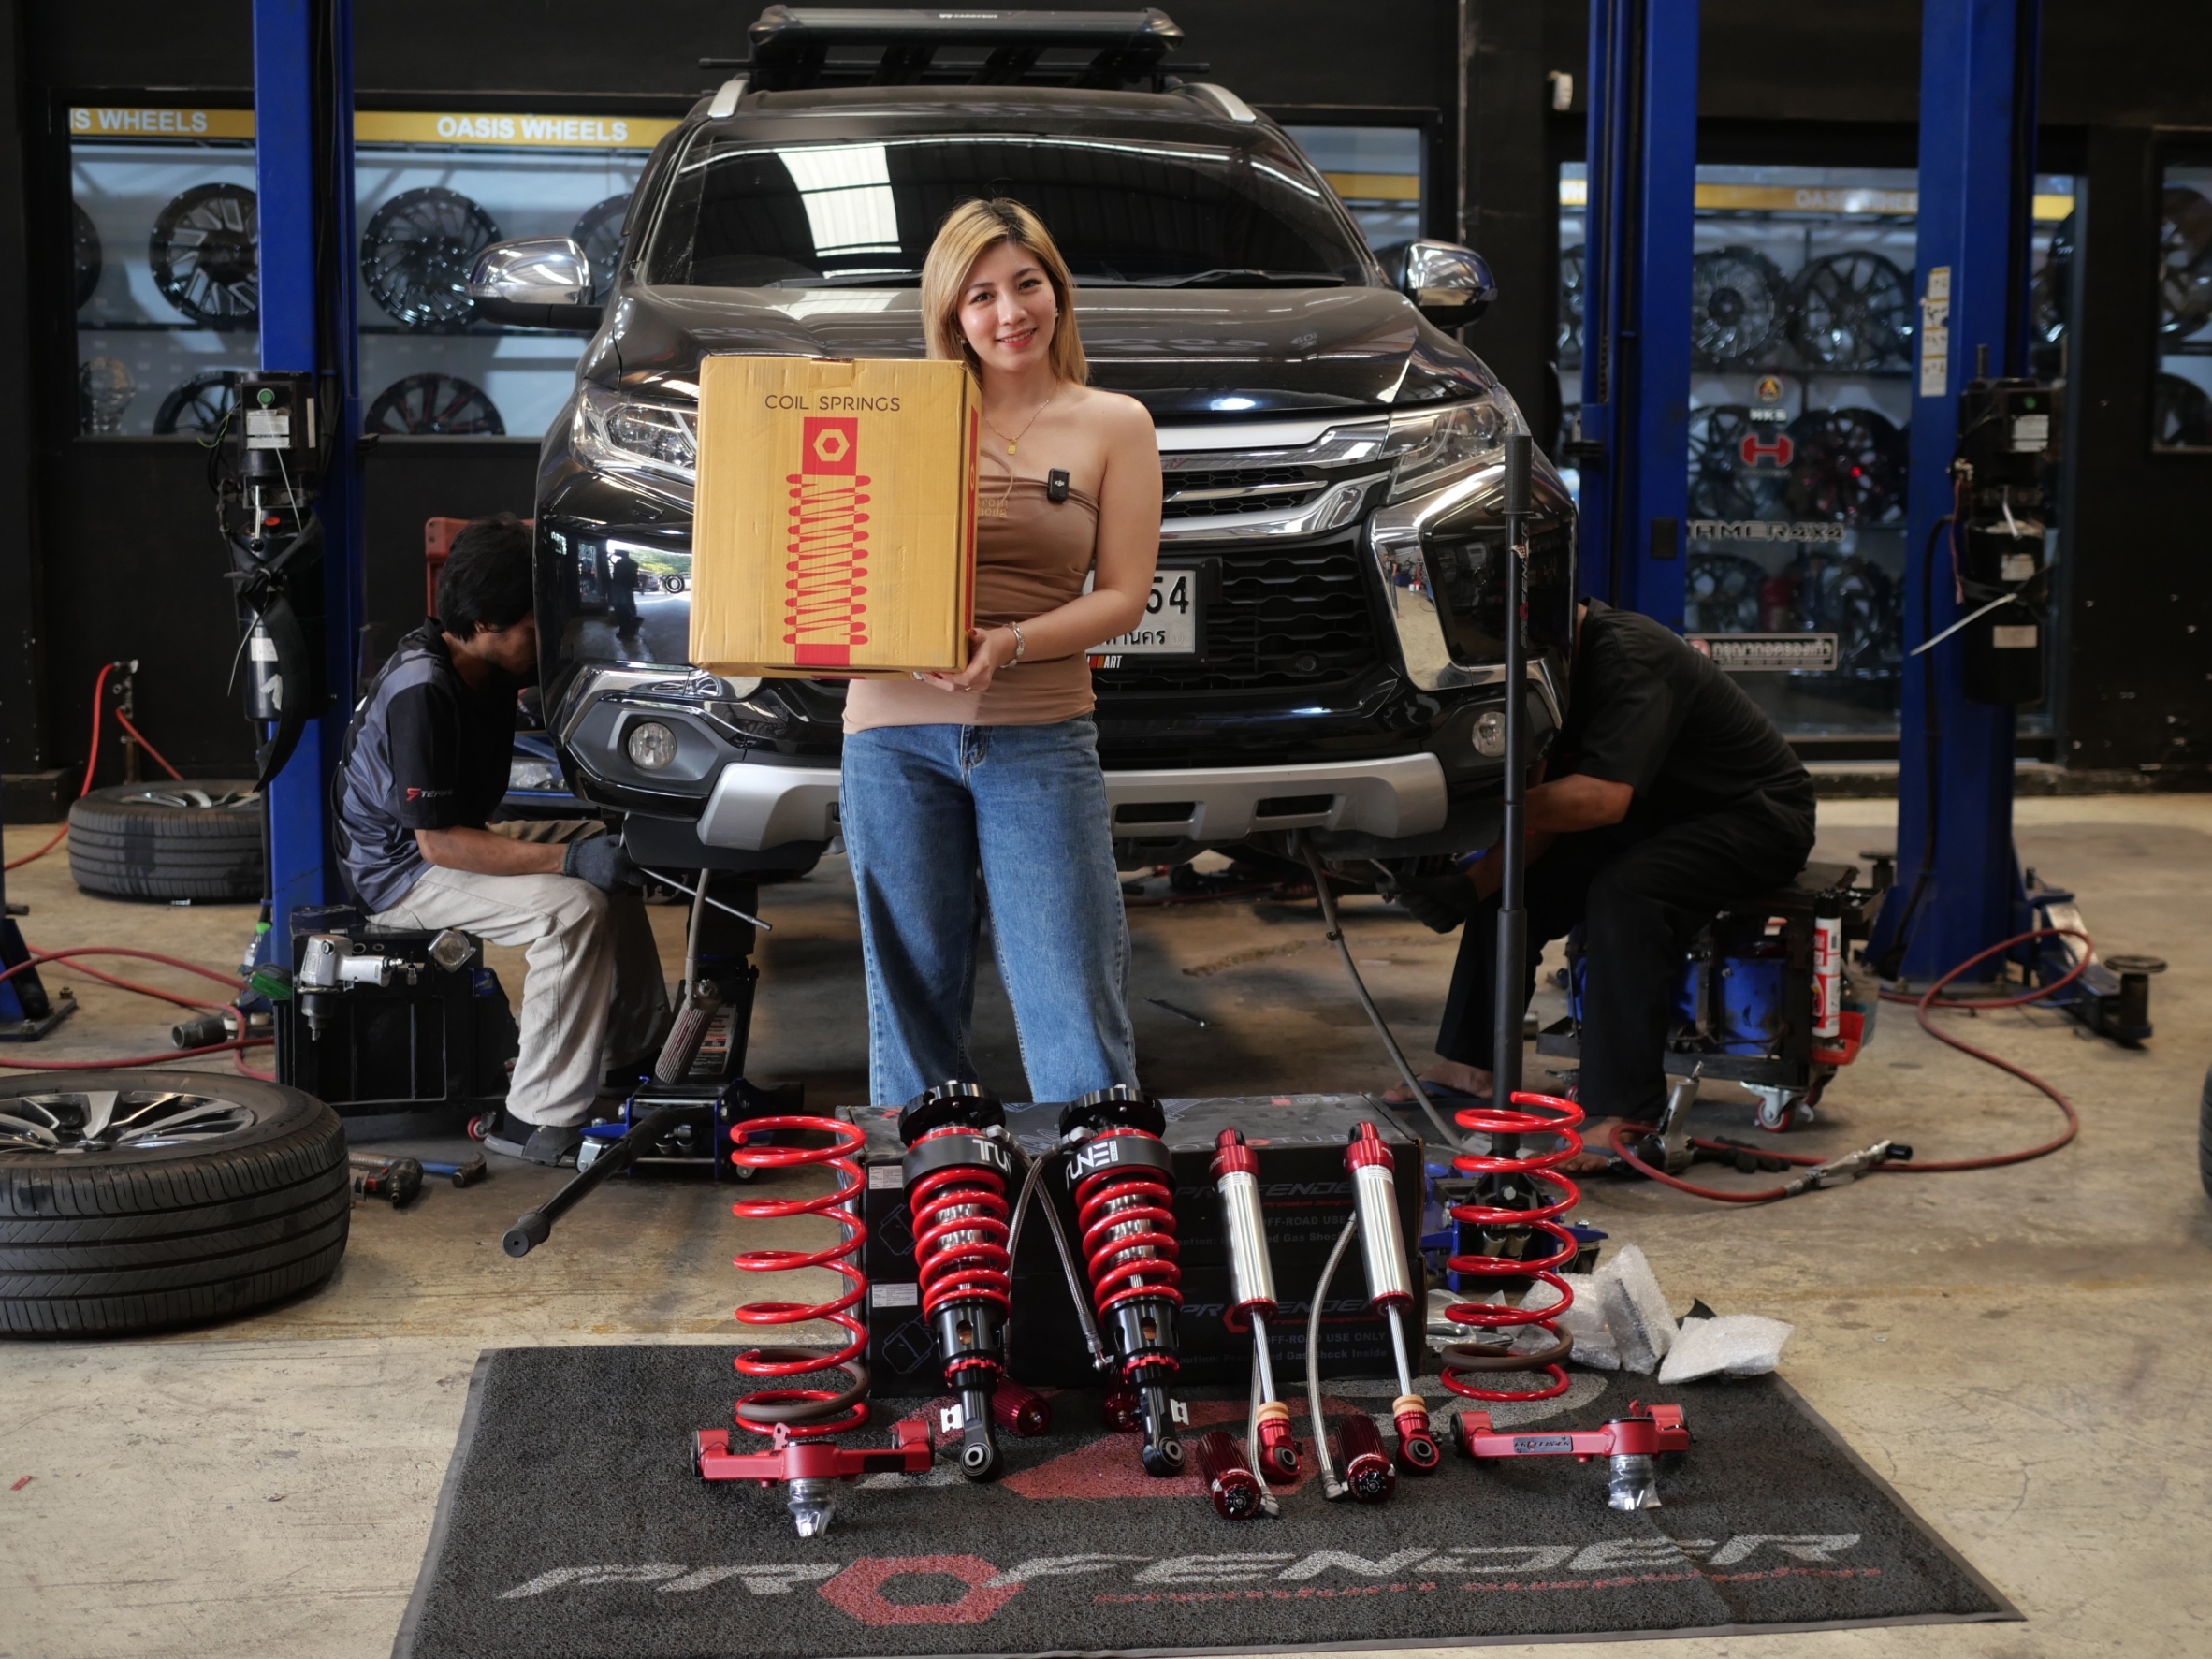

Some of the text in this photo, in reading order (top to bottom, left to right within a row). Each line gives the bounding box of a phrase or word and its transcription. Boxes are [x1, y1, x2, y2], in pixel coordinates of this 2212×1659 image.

[98, 110, 208, 132] WHEELS
[437, 117, 628, 141] OASIS WHEELS
[765, 395, 900, 411] COIL SPRINGS
[1322, 1215, 1347, 1225] USE
[1179, 1237, 1215, 1246] aution:
[1283, 1233, 1306, 1243] Gas
[1326, 1332, 1350, 1343] USE
[1353, 1332, 1387, 1341] ONLY
[1179, 1355, 1220, 1364] aution:
[1317, 1349, 1348, 1360] hock
[1352, 1348, 1388, 1358] Inside
[500, 1533, 1862, 1626] PROFENDER
